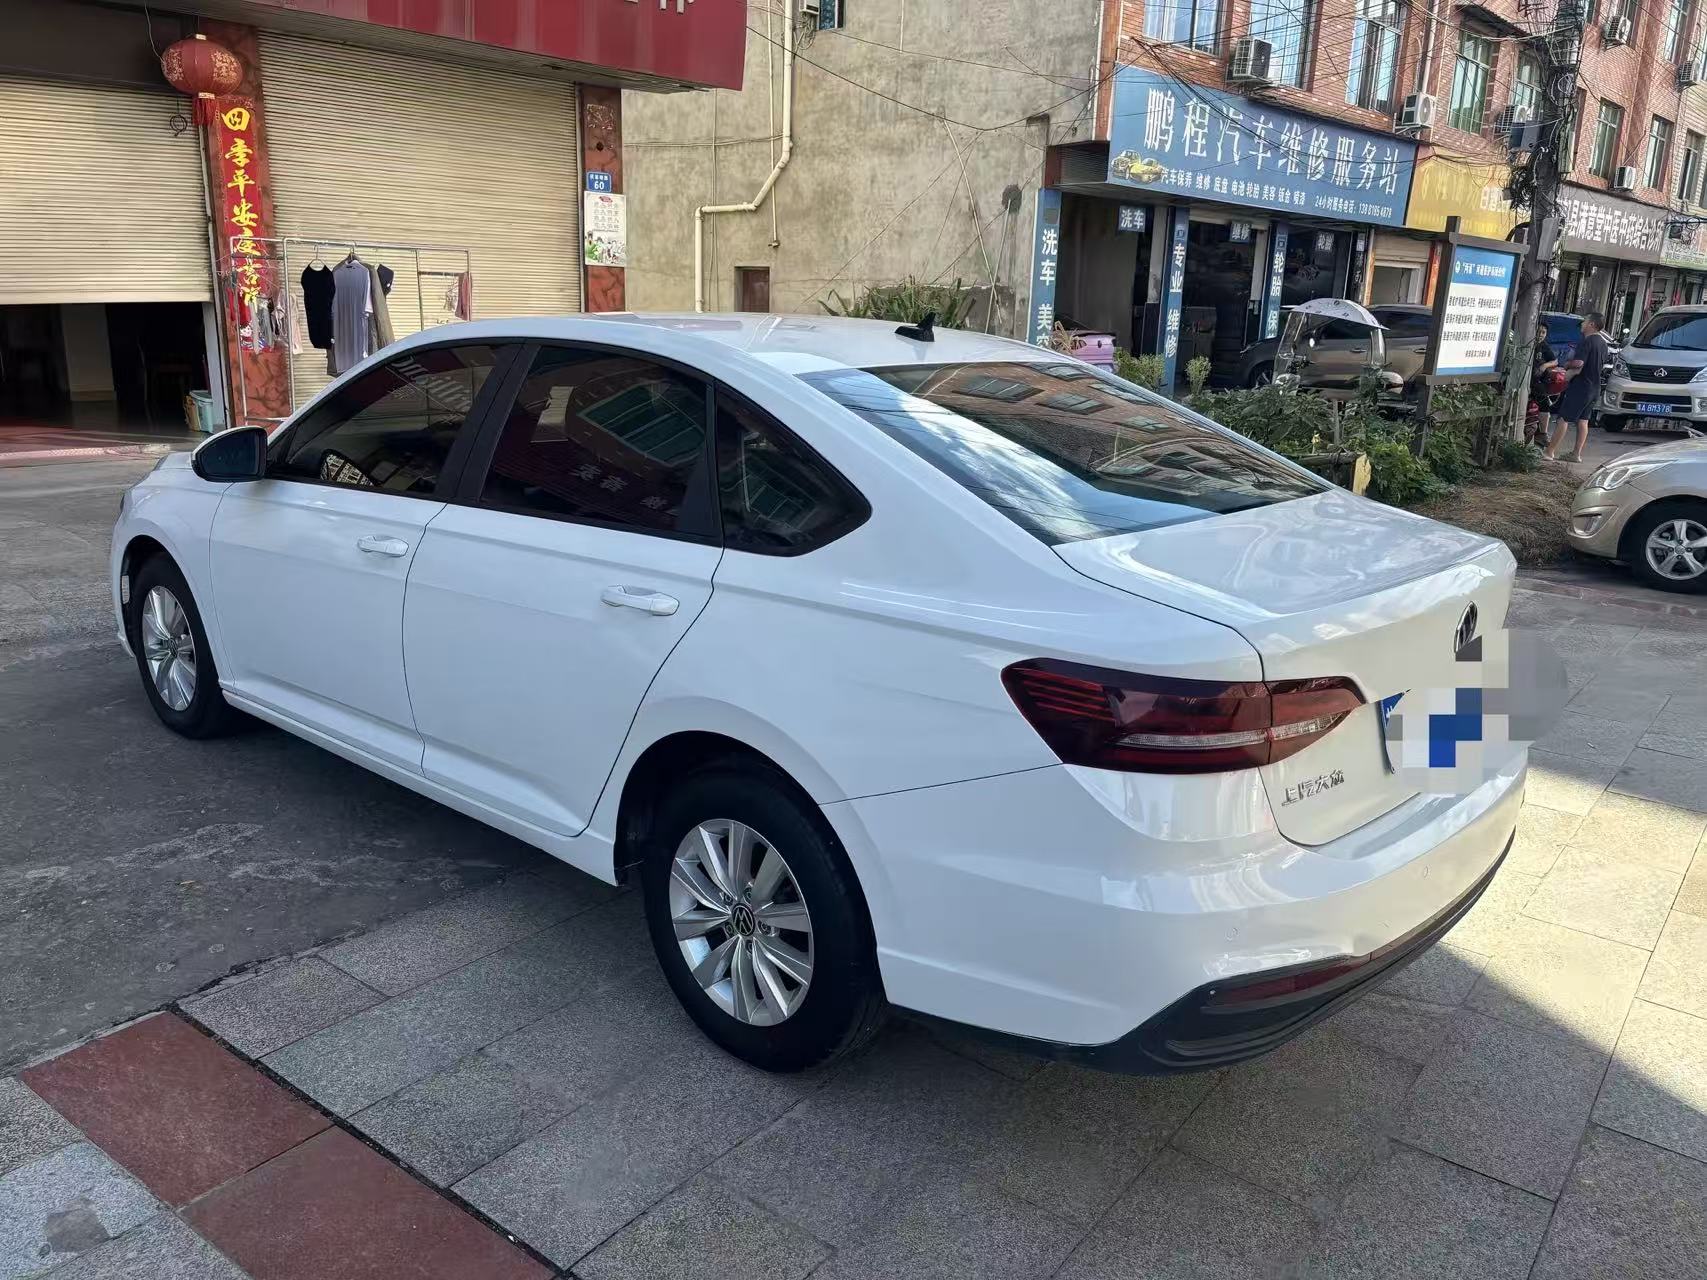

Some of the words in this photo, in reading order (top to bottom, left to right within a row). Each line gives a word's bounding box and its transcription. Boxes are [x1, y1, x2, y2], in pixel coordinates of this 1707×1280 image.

[1144, 88, 1399, 195] 鹏程汽车维修服务站
[594, 181, 605, 190] 60
[1161, 168, 1192, 188] 汽车保养
[1196, 172, 1211, 190] 维修
[1214, 177, 1228, 193] 底盘
[1231, 180, 1245, 196] 电池
[1246, 181, 1260, 199] 轮胎
[1262, 184, 1276, 201] 美容
[1278, 187, 1291, 203] 钣金
[1120, 208, 1145, 229] 洗车
[1040, 228, 1058, 286] 洗车
[1169, 243, 1186, 293] 专业
[1270, 252, 1285, 297] 轮胎
[1165, 309, 1181, 358] 维修
[1281, 769, 1345, 807] 上汽大众
